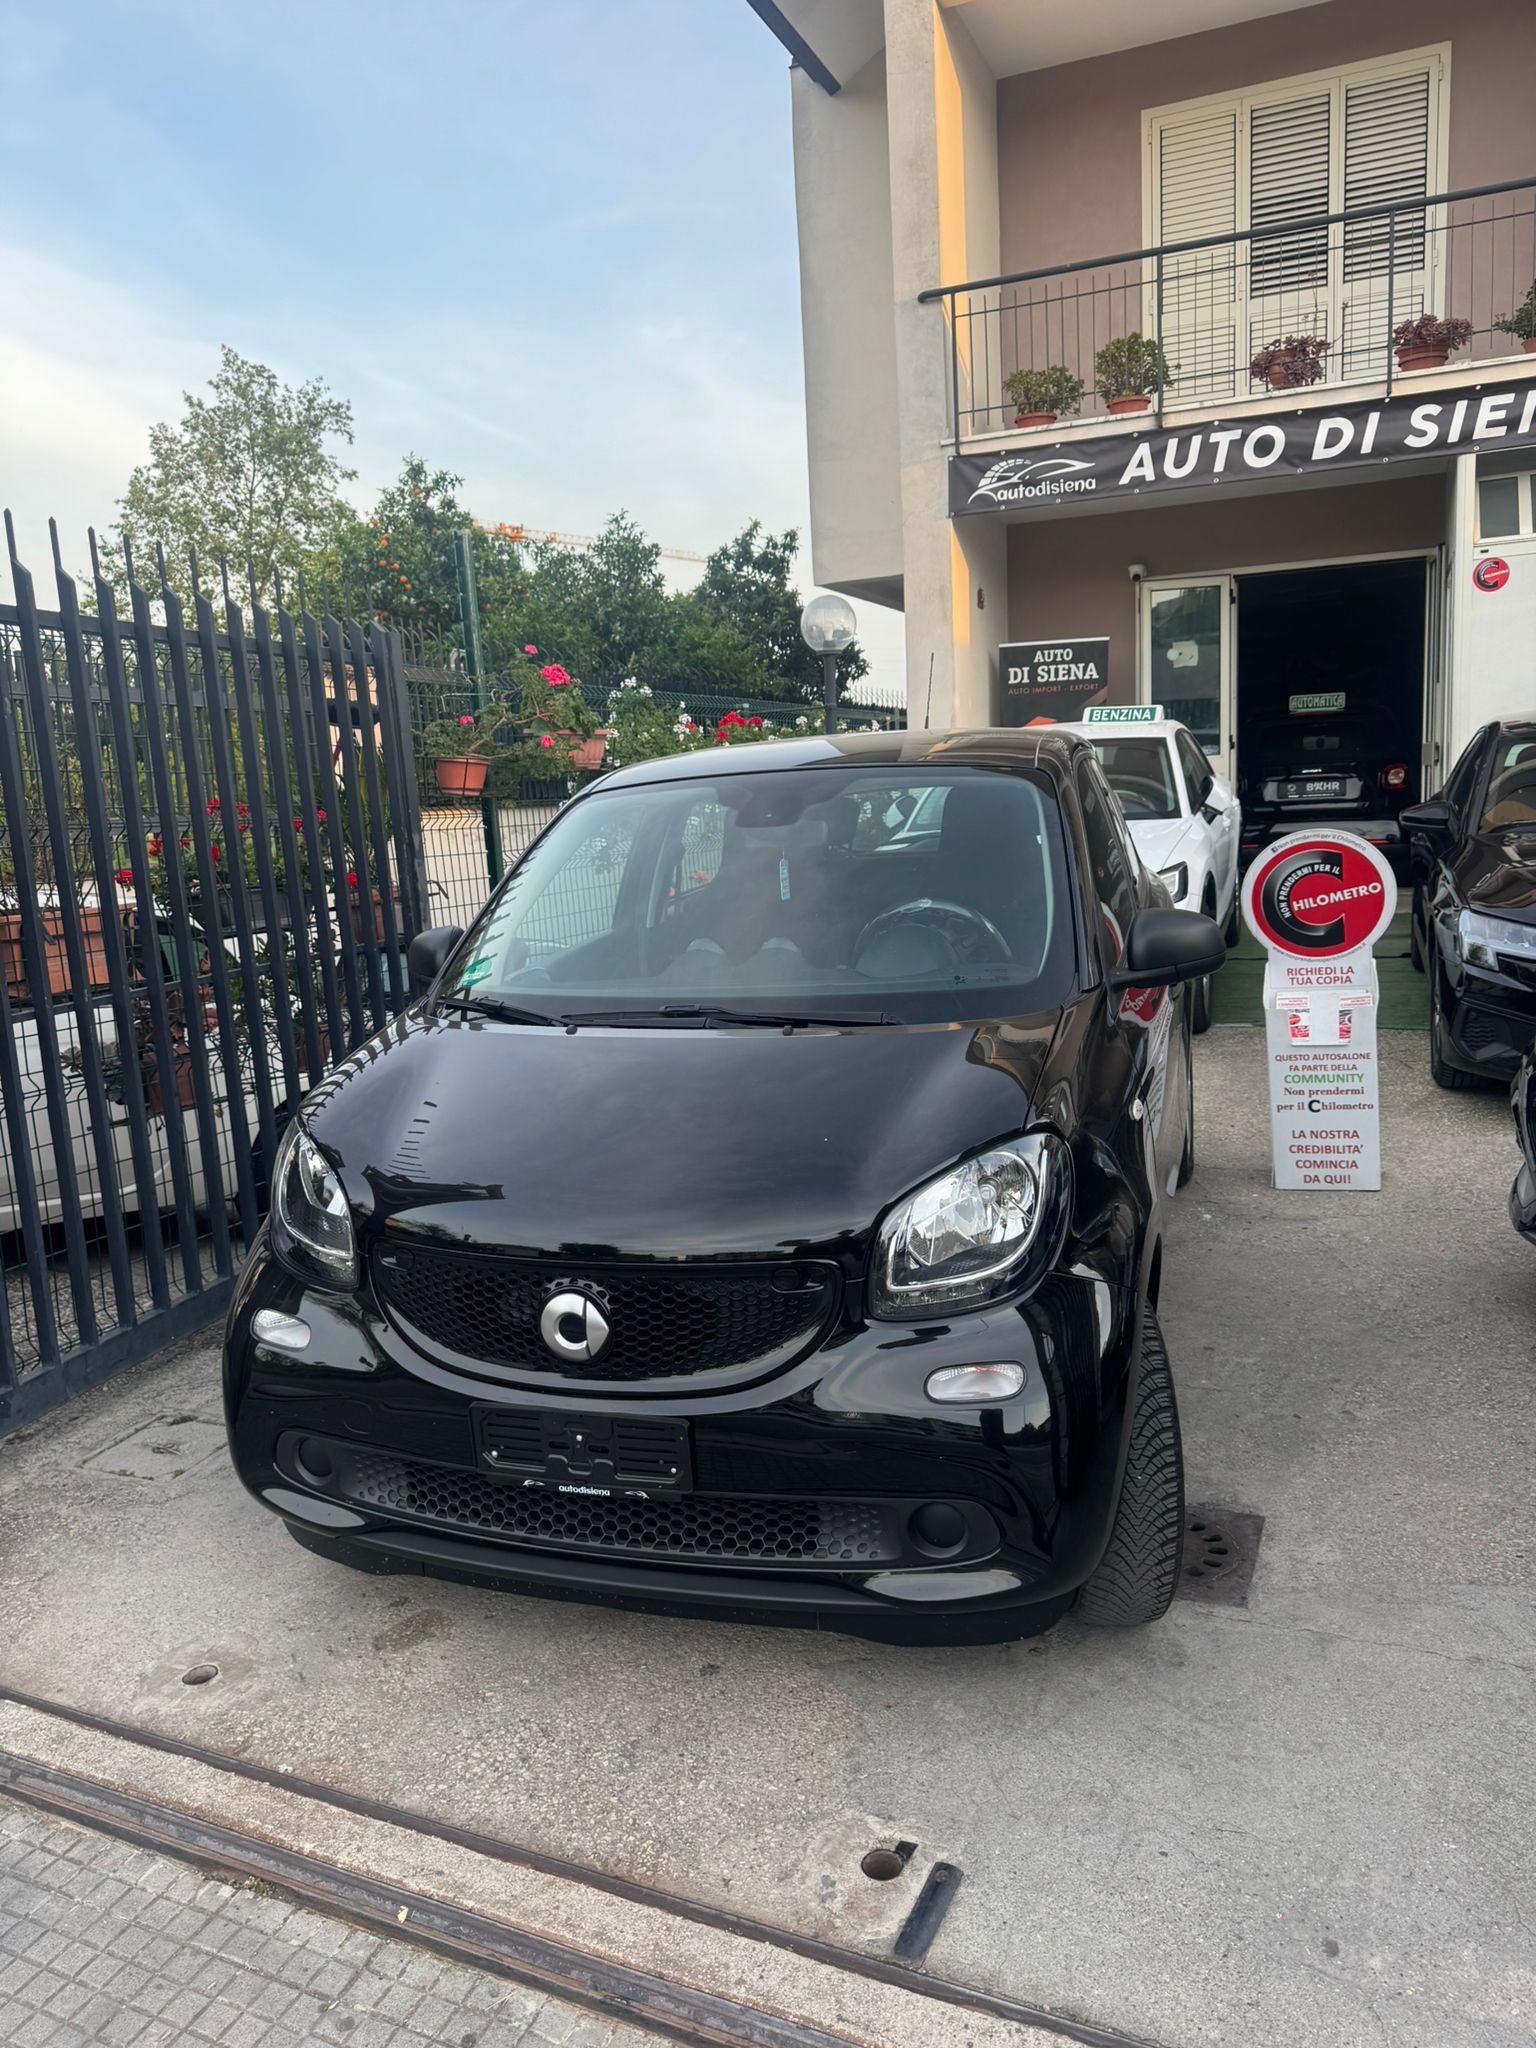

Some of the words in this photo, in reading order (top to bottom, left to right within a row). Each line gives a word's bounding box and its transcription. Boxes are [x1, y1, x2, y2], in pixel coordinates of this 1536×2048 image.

[1118, 424, 1287, 486] AUTO
[1311, 411, 1381, 461] DI
[997, 477, 1097, 502] autodisiena
[1033, 648, 1073, 663] AUTO
[1008, 667, 1030, 684] DI
[1037, 662, 1099, 682] SIENA
[1032, 686, 1062, 694] IMPORT
[1070, 683, 1099, 691] EXPORT
[1291, 695, 1343, 708] AUTOMATICA
[1092, 708, 1151, 721] BENZINA
[1314, 864, 1331, 872] PER
[1332, 866, 1340, 874] IL
[1278, 866, 1313, 900] PRENDERMI
[1279, 902, 1292, 918] NON
[1286, 966, 1337, 977] RICHIEDI
[1340, 966, 1354, 974] LA
[1289, 976, 1313, 986] TUA
[1316, 975, 1352, 985] COPIA
[1275, 1054, 1310, 1062] QUESTO
[1312, 1052, 1371, 1061] AUTOSALONE
[1302, 1064, 1329, 1072] PARTE
[1331, 1063, 1358, 1071] DELLA
[1284, 1073, 1364, 1084] COMMUNITY
[1284, 1087, 1305, 1096] Non
[1308, 1086, 1365, 1098] prendermi
[1276, 1103, 1294, 1112] per
[1297, 1102, 1305, 1110] il
[1308, 1099, 1374, 1113] Chilometro
[1292, 1130, 1306, 1139] LA
[1310, 1130, 1360, 1139] NOSTRA
[1295, 1160, 1358, 1169] COMINCIA
[1303, 1175, 1321, 1184] DA
[1324, 1175, 1351, 1185] QUI!
[558, 1484, 611, 1497] autodisiena
